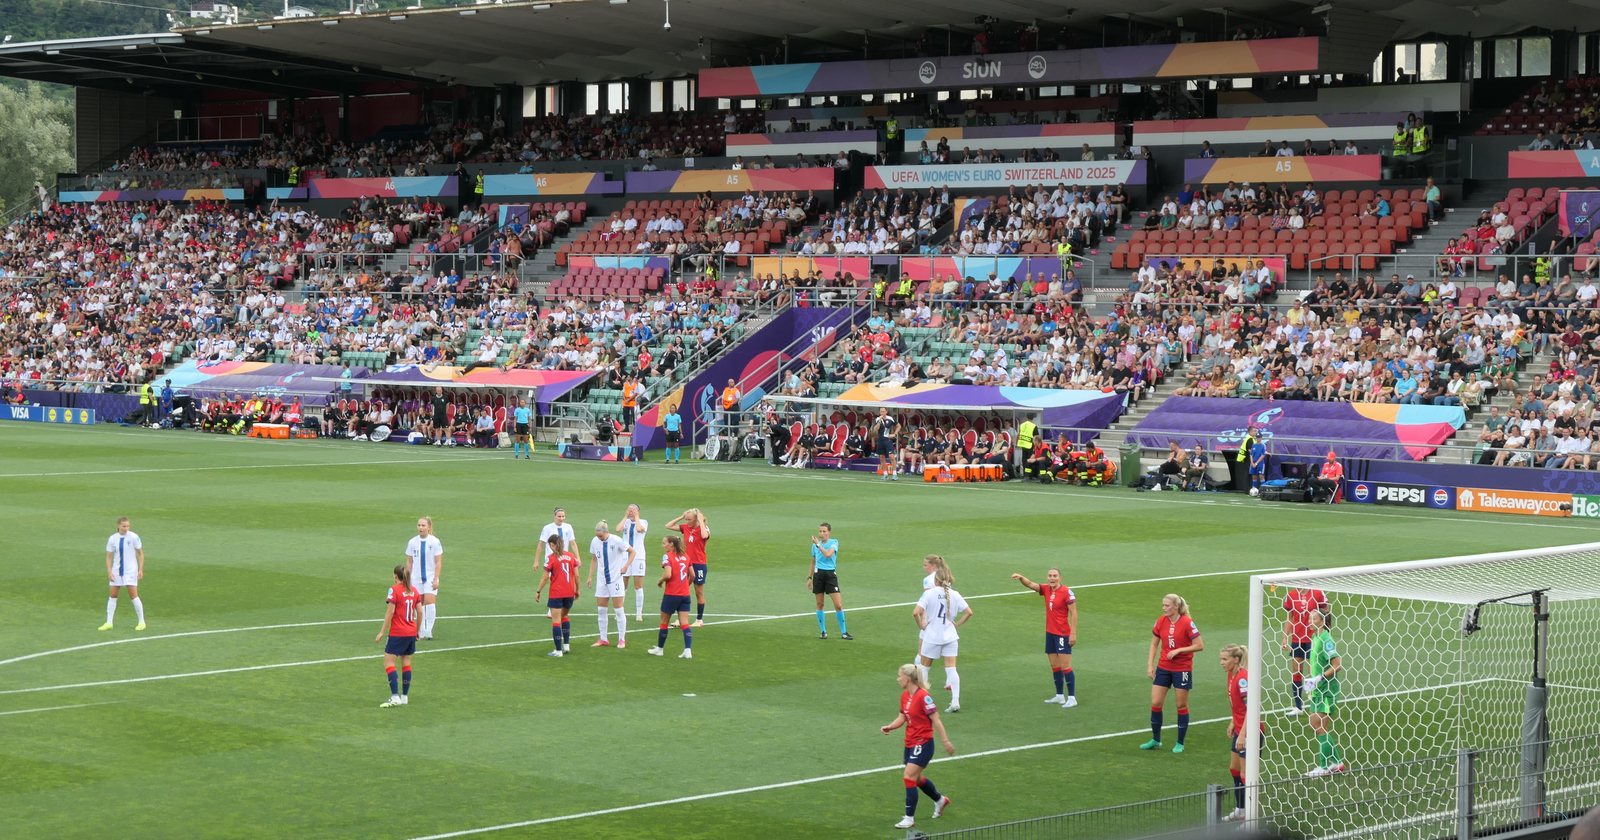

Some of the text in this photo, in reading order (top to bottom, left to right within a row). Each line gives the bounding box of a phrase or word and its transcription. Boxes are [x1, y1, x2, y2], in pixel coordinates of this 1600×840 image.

[962, 61, 1001, 78] SION
[892, 167, 1116, 182] UEFA WOMEN'S EURO SWITZERLAND 2025
[1275, 161, 1291, 172] A5
[385, 182, 395, 190] A6
[537, 178, 547, 187] A6
[727, 175, 738, 184] A5
[10, 407, 29, 419] VISA
[1377, 487, 1425, 503] PEPSI
[1572, 497, 1600, 517] He
[562, 562, 570, 583] 4
[680, 562, 687, 581] 2
[405, 600, 414, 622] 11
[937, 602, 946, 625] 4
